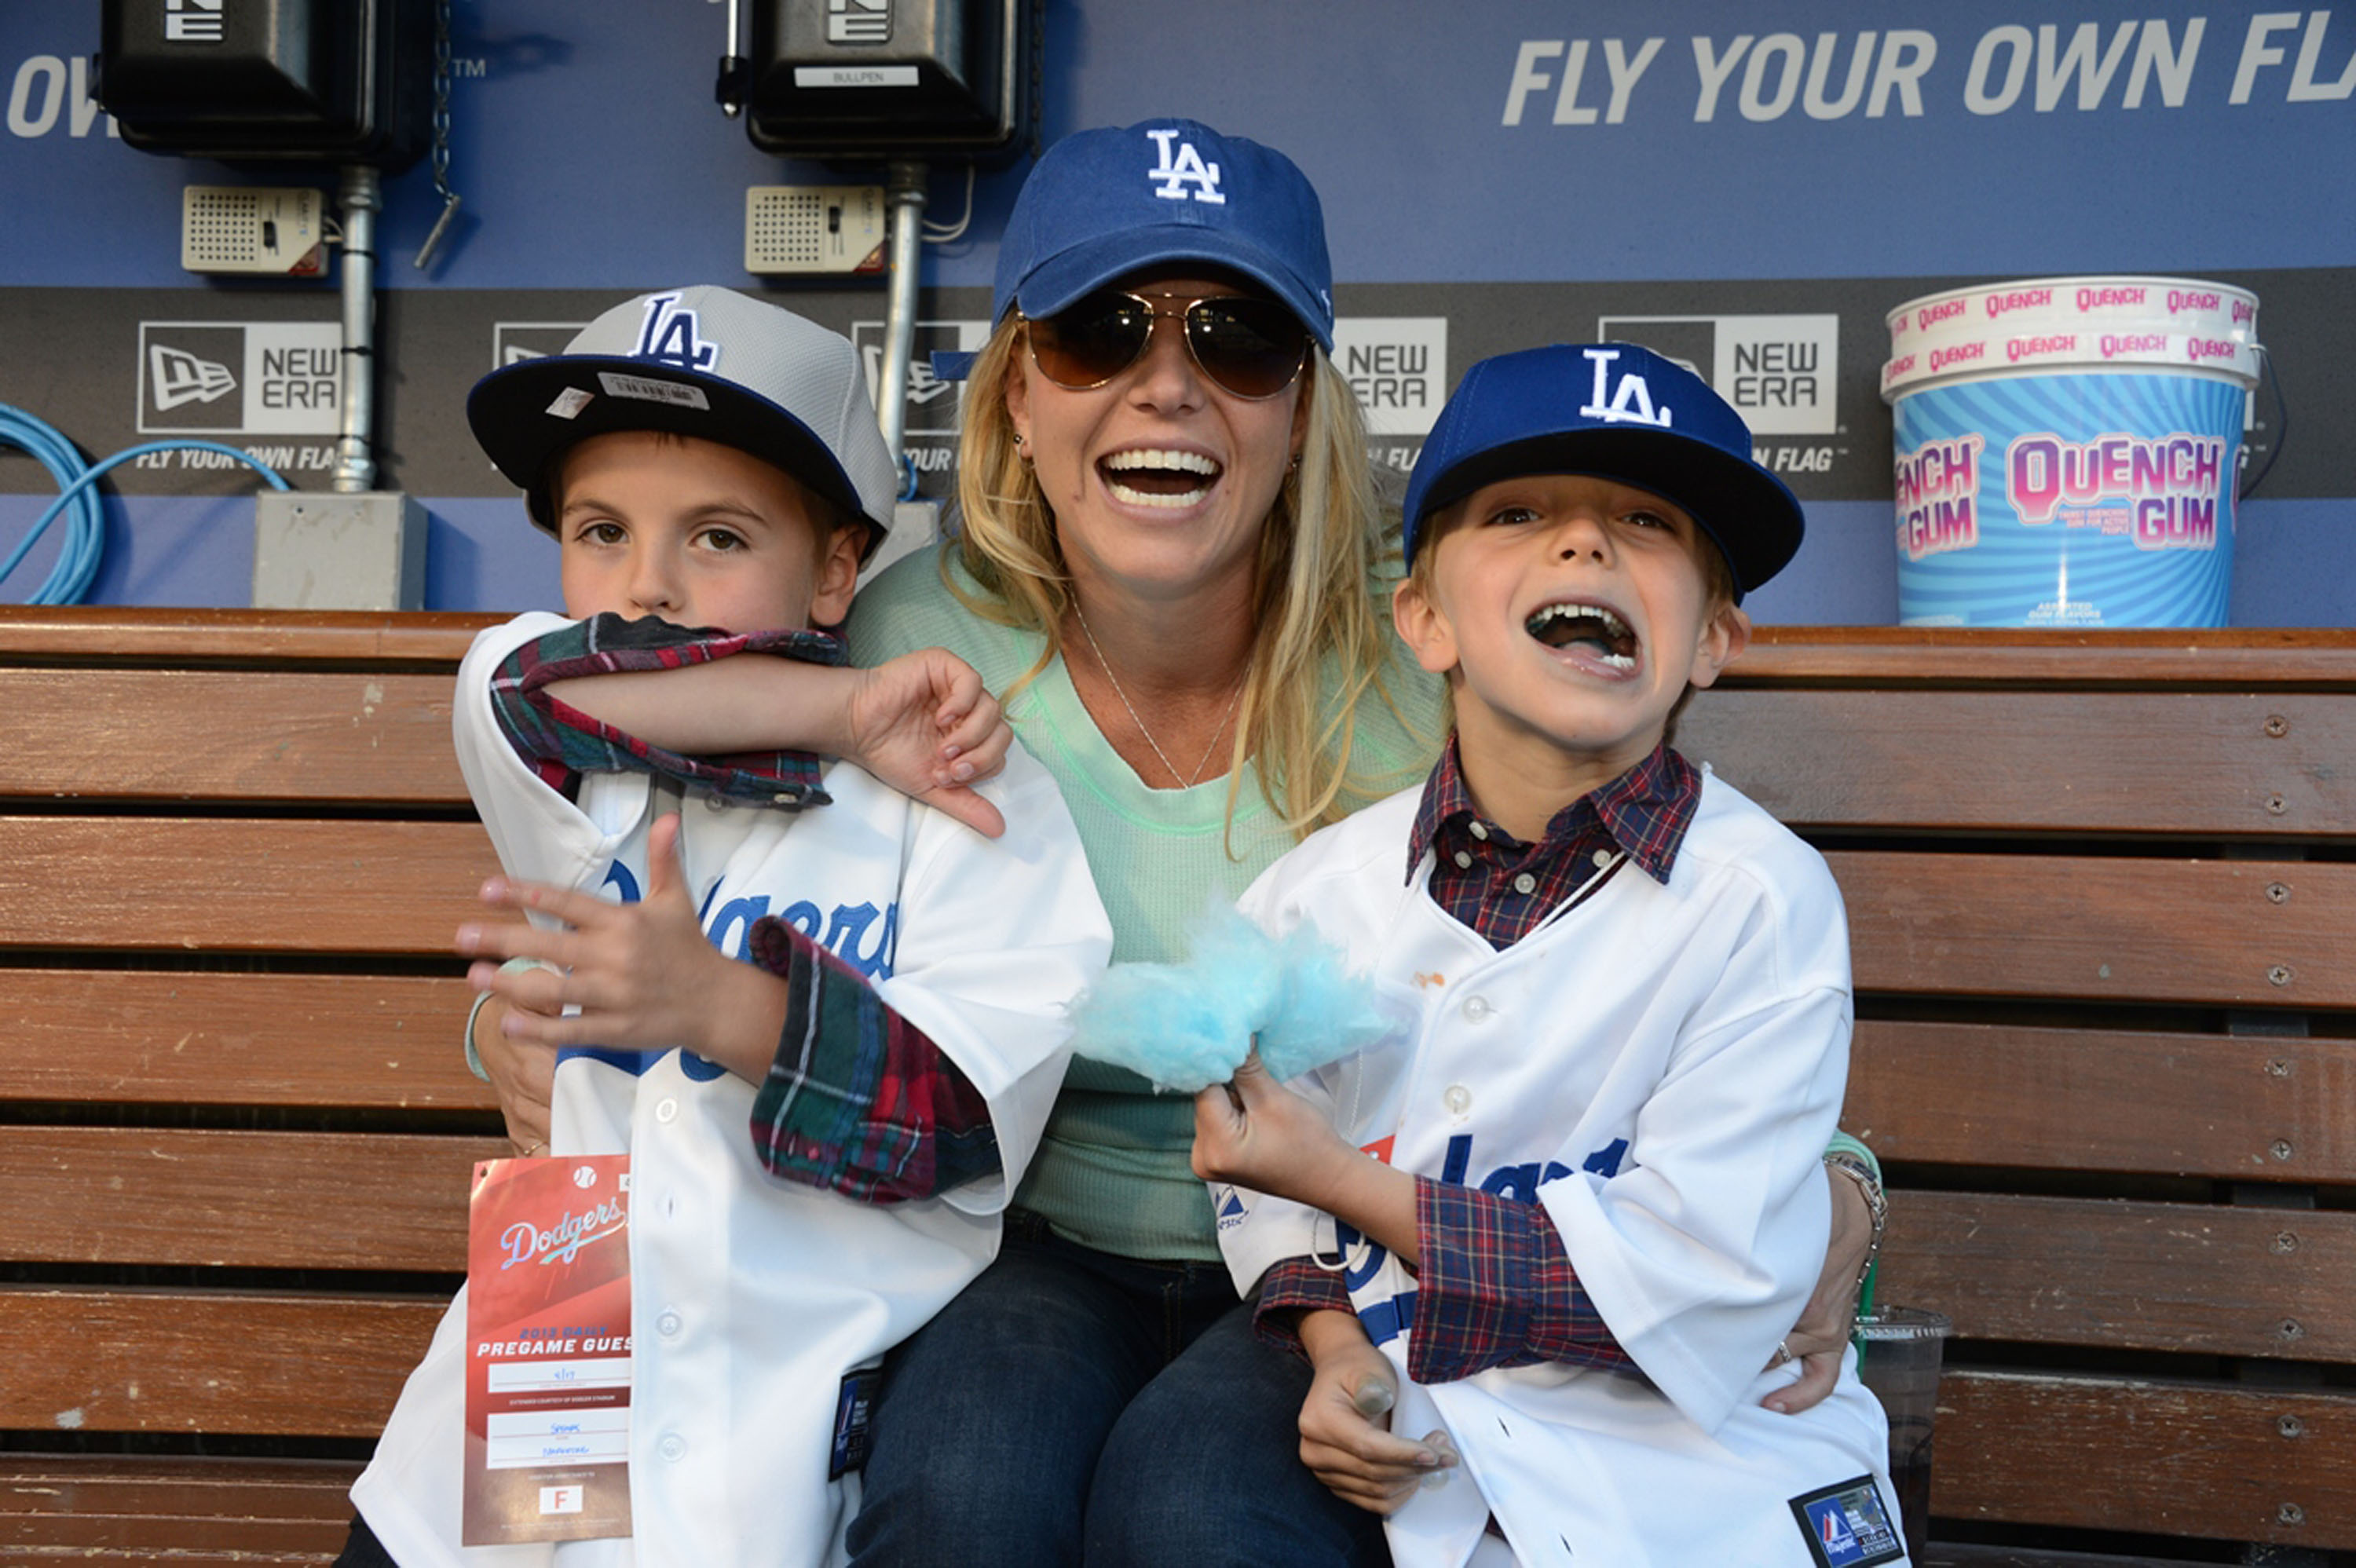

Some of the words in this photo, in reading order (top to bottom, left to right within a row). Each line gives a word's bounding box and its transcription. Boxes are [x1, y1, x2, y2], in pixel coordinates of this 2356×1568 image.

[832, 71, 884, 83] BULLPEN
[1501, 37, 1666, 126] FLY
[1691, 29, 1938, 122] YOUR
[1963, 16, 2208, 115] OWN
[2228, 10, 2356, 105] FL
[1147, 130, 1226, 204] LA
[1985, 289, 2052, 319] QUENCH
[2076, 287, 2147, 313] QUENCH
[2167, 290, 2222, 314] QUENCH
[630, 291, 719, 371] LA
[262, 349, 338, 377] NEW
[1348, 345, 1428, 375] NEW
[1734, 342, 1818, 374] NEW
[1930, 342, 1985, 372] QUENCH
[2007, 334, 2077, 363] QUENCH
[2100, 334, 2168, 358] QUENCH
[2187, 337, 2236, 360] QUENCH
[262, 380, 336, 408] ERA
[1348, 378, 1426, 408] ERA
[1579, 349, 1672, 427] LA
[1734, 377, 1817, 408] ERA
[298, 446, 338, 470] FLA
[903, 448, 953, 471] OUR
[1774, 447, 1834, 472] FLAG
[2013, 438, 2219, 520] QUENCH
[1909, 497, 1973, 552] GUM
[2137, 495, 2215, 546] GUM
[500, 1196, 625, 1270] Dodgers
[477, 1338, 578, 1358] PREGAME
[554, 1490, 569, 1509] F
